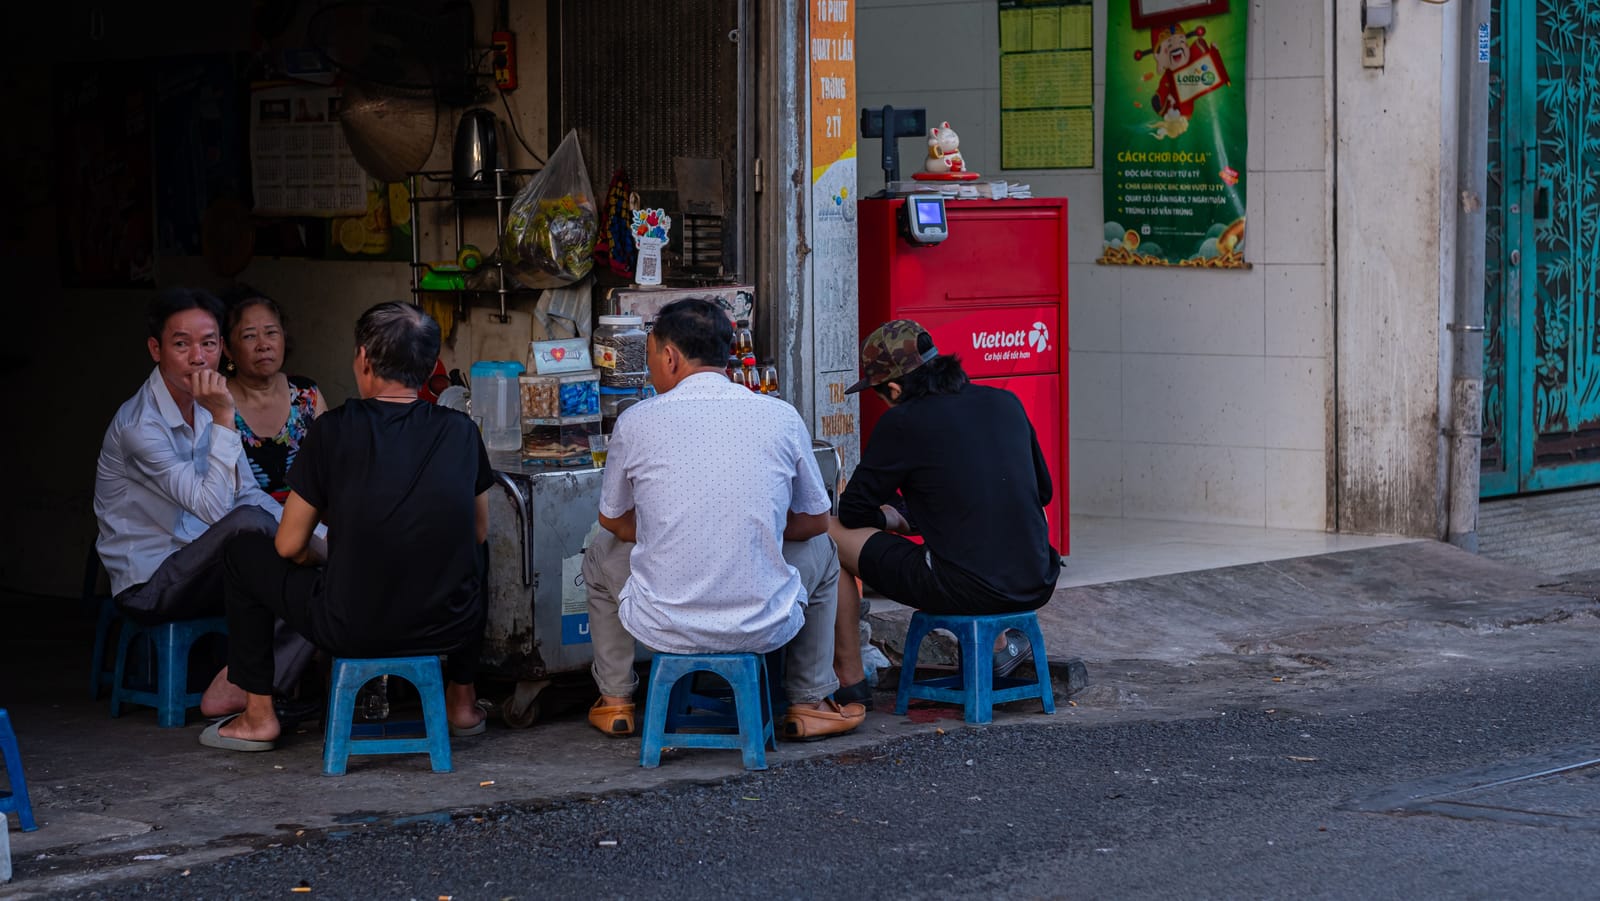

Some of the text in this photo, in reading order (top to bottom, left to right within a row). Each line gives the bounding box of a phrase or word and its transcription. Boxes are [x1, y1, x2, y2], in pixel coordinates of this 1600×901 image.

[832, 39, 837, 61] 1
[1177, 74, 1200, 83] Lotto
[826, 115, 832, 138] 2
[1117, 150, 1146, 162] CÁCH
[972, 330, 1026, 349] Vietlott
